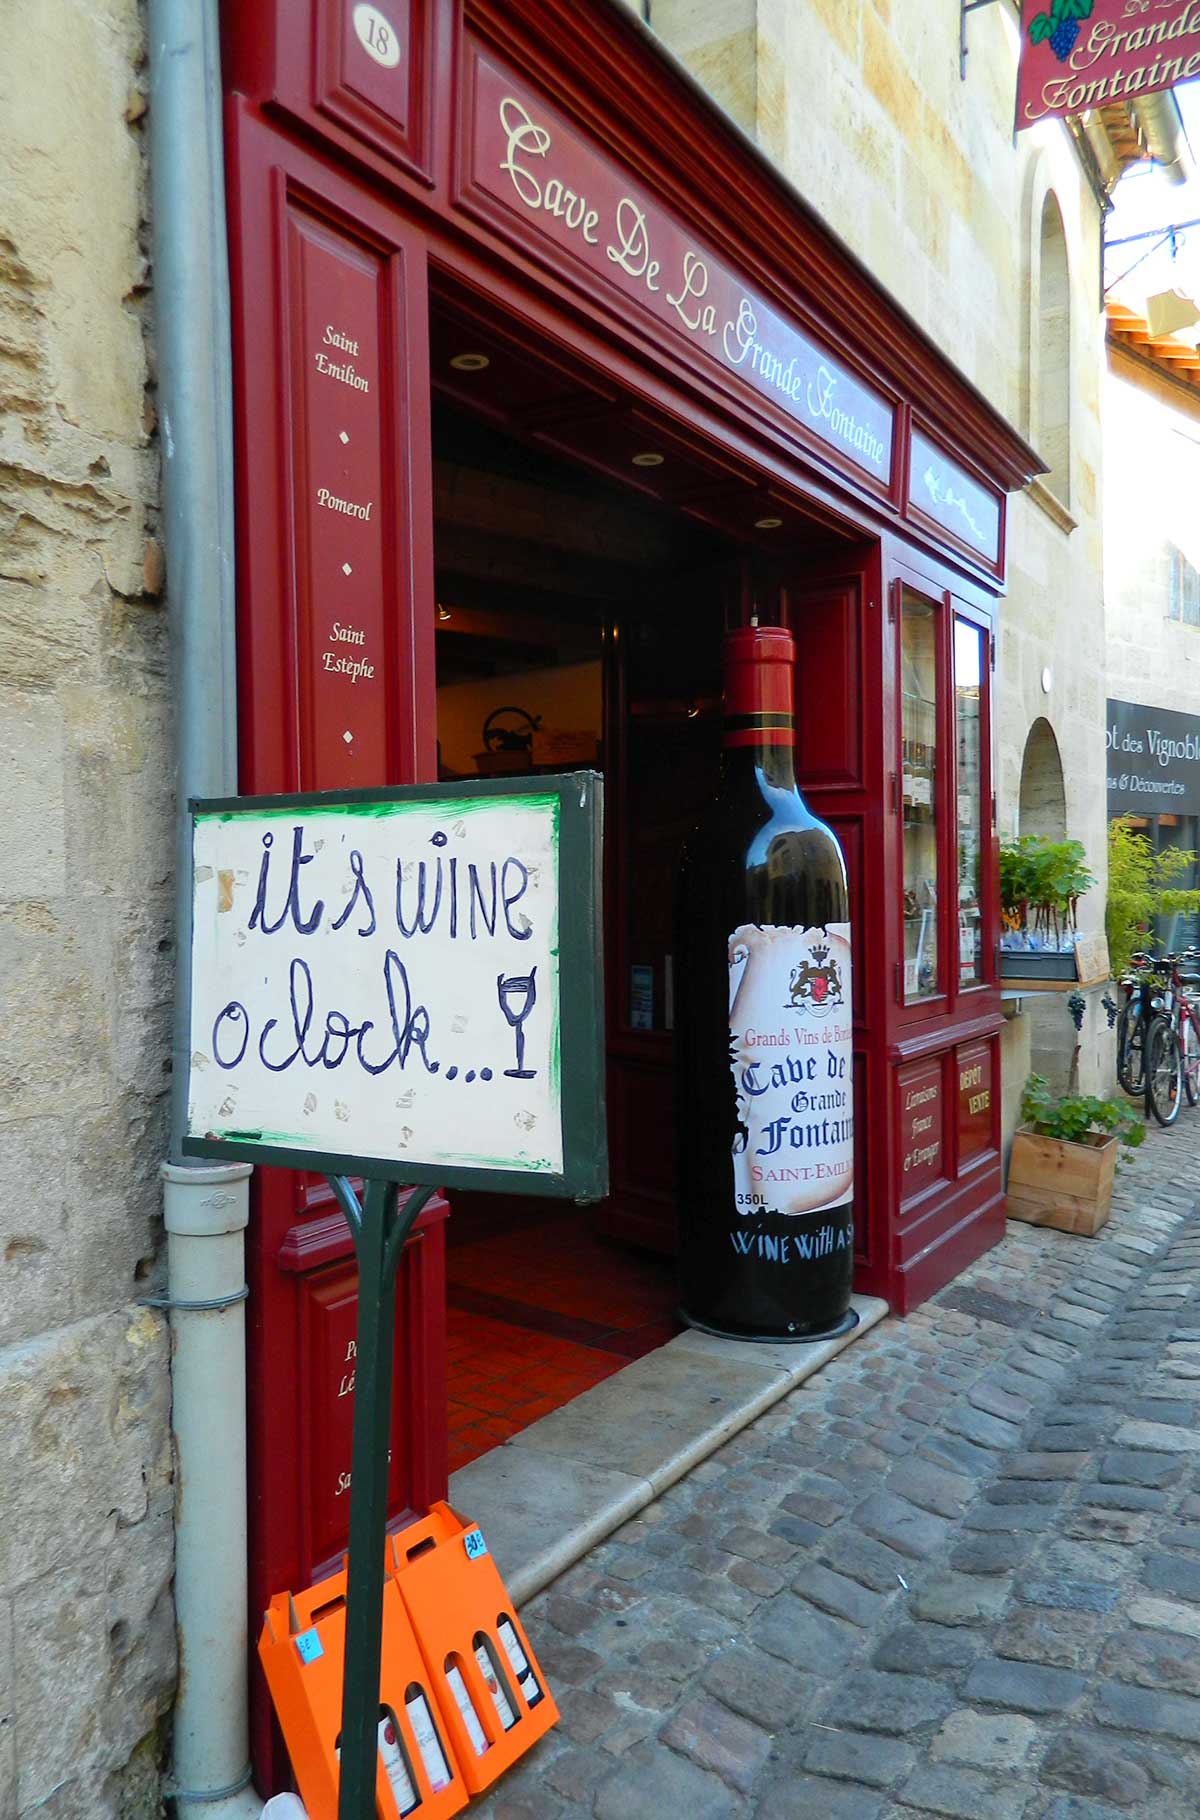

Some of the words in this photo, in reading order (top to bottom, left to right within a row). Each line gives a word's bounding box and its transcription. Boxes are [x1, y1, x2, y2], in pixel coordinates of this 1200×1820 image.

[366, 16, 389, 56] 18
[1069, 0, 1200, 70] Grande
[1024, 52, 1200, 119] Fontaine
[499, 97, 599, 244] Cave
[606, 198, 660, 291] De
[666, 251, 717, 336] La
[723, 298, 801, 403] Grande
[807, 365, 884, 464] Fontaine
[322, 325, 359, 356] Saint
[315, 353, 369, 393] Emilion
[317, 487, 373, 521] Pomerol
[329, 622, 366, 646] Saint
[322, 652, 375, 684] Estèphe
[1121, 733, 1143, 754] des
[1129, 775, 1185, 796] Découvertes
[248, 826, 376, 936] it's
[744, 1028, 790, 1048] Grands
[795, 1027, 819, 1046] Vins
[822, 1025, 833, 1044] de
[741, 1054, 817, 1097] Cave
[828, 1049, 846, 1080] de
[791, 1089, 847, 1113] Grande
[737, 1193, 769, 1206] 350L
[836, 1229, 846, 1249] A
